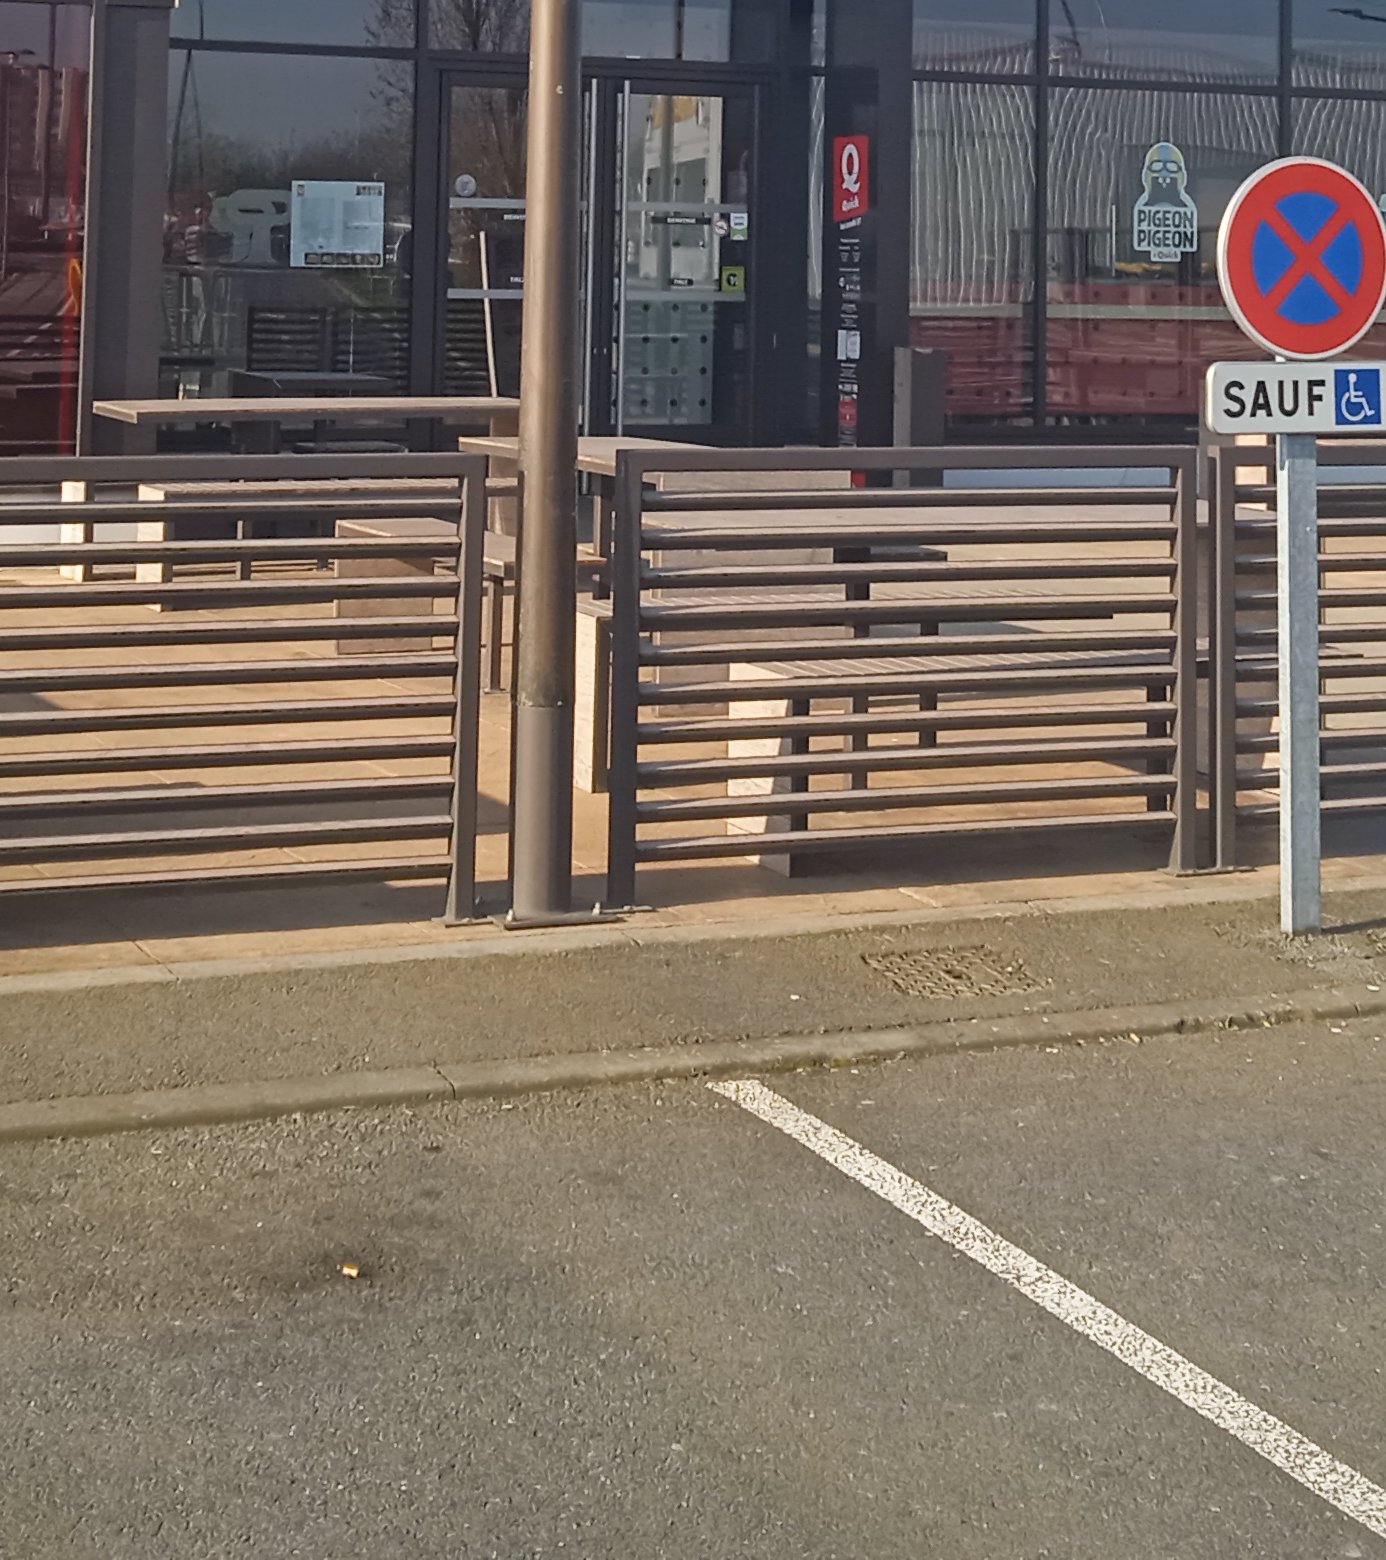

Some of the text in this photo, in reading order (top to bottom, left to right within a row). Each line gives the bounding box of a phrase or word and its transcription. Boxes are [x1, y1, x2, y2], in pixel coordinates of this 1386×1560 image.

[841, 143, 861, 193] Q
[1138, 209, 1194, 229] PIGEON
[1138, 230, 1194, 249] PIGEON
[1223, 380, 1326, 418] SAUF
